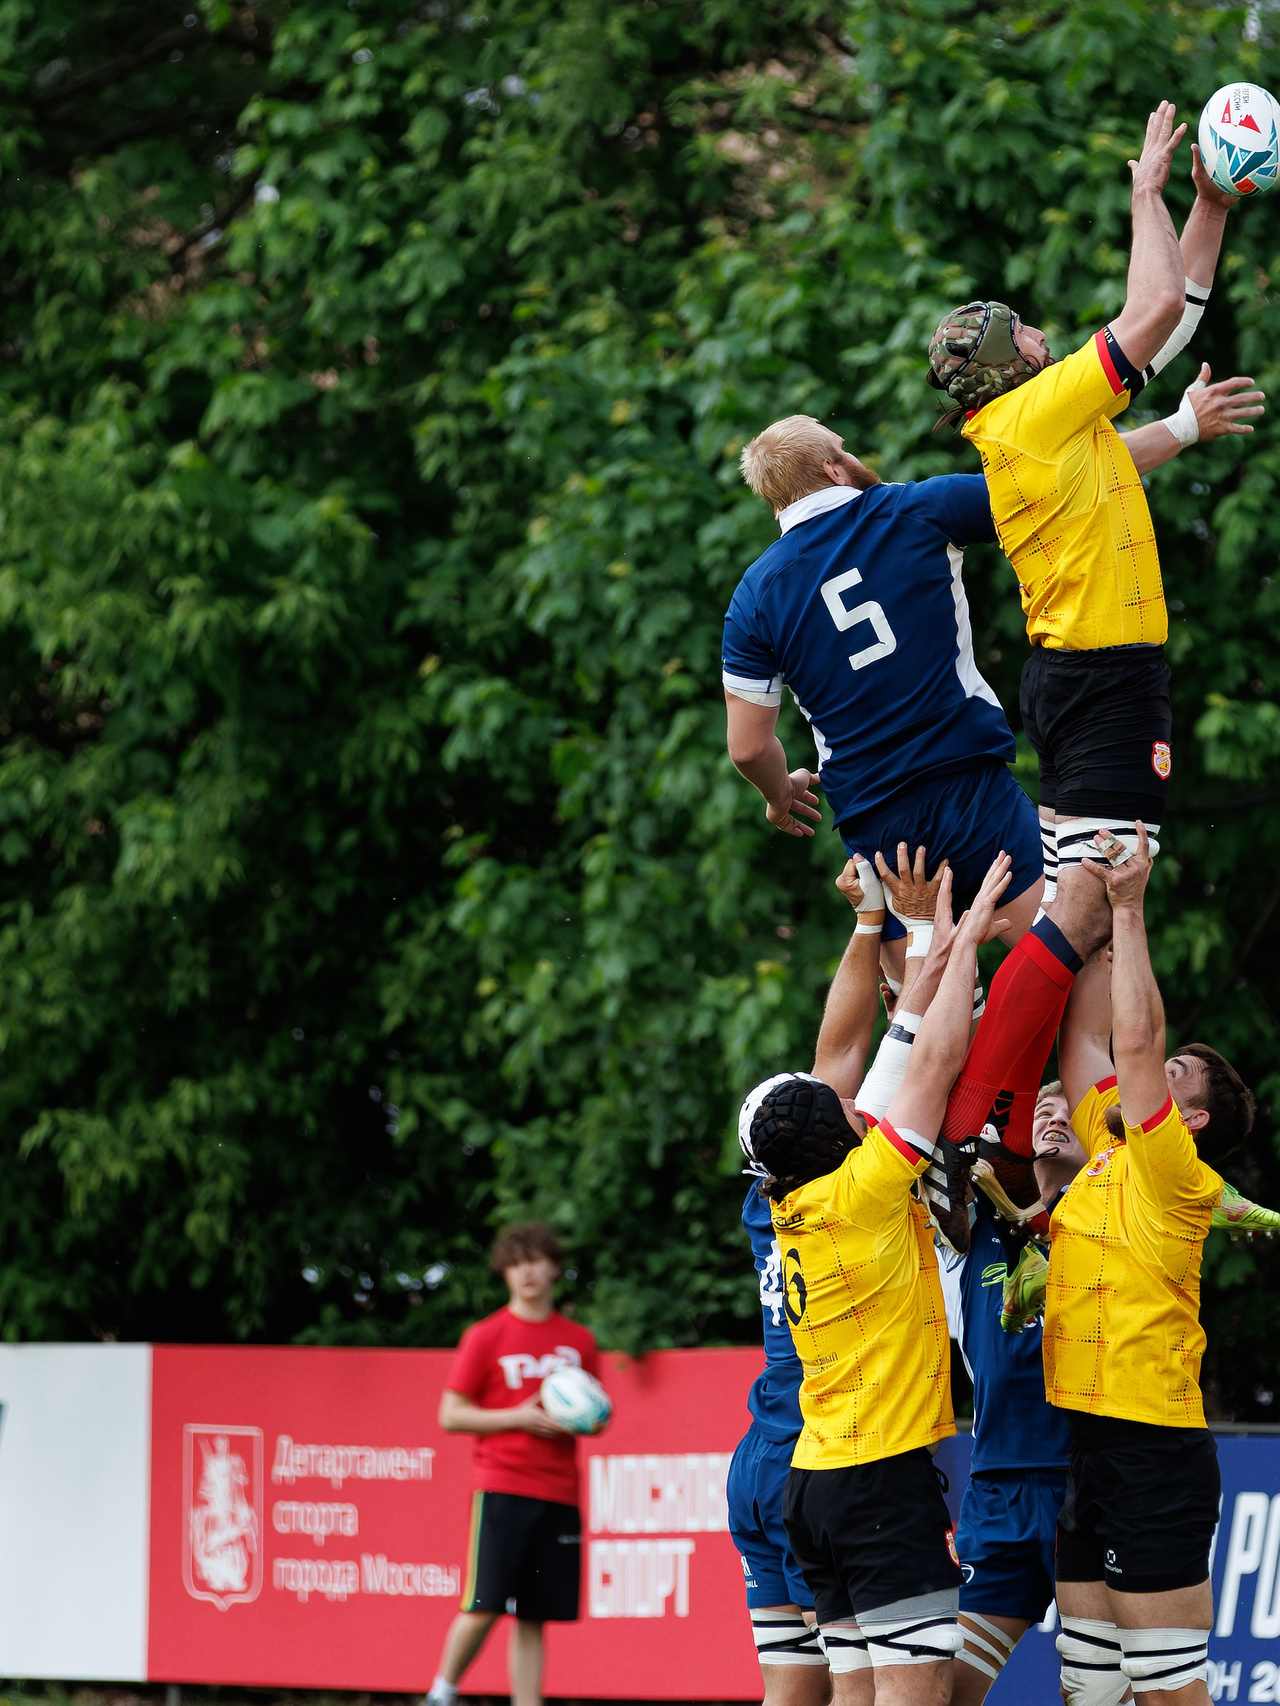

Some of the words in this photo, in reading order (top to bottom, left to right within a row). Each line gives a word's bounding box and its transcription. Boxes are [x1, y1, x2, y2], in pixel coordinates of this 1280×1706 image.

[820, 567, 897, 671] 5
[271, 1434, 436, 1490] Департамент
[272, 1500, 359, 1547] спорта
[273, 1557, 360, 1603] города
[360, 1552, 461, 1597] Москвы
[588, 1538, 696, 1618] СПОРТ
